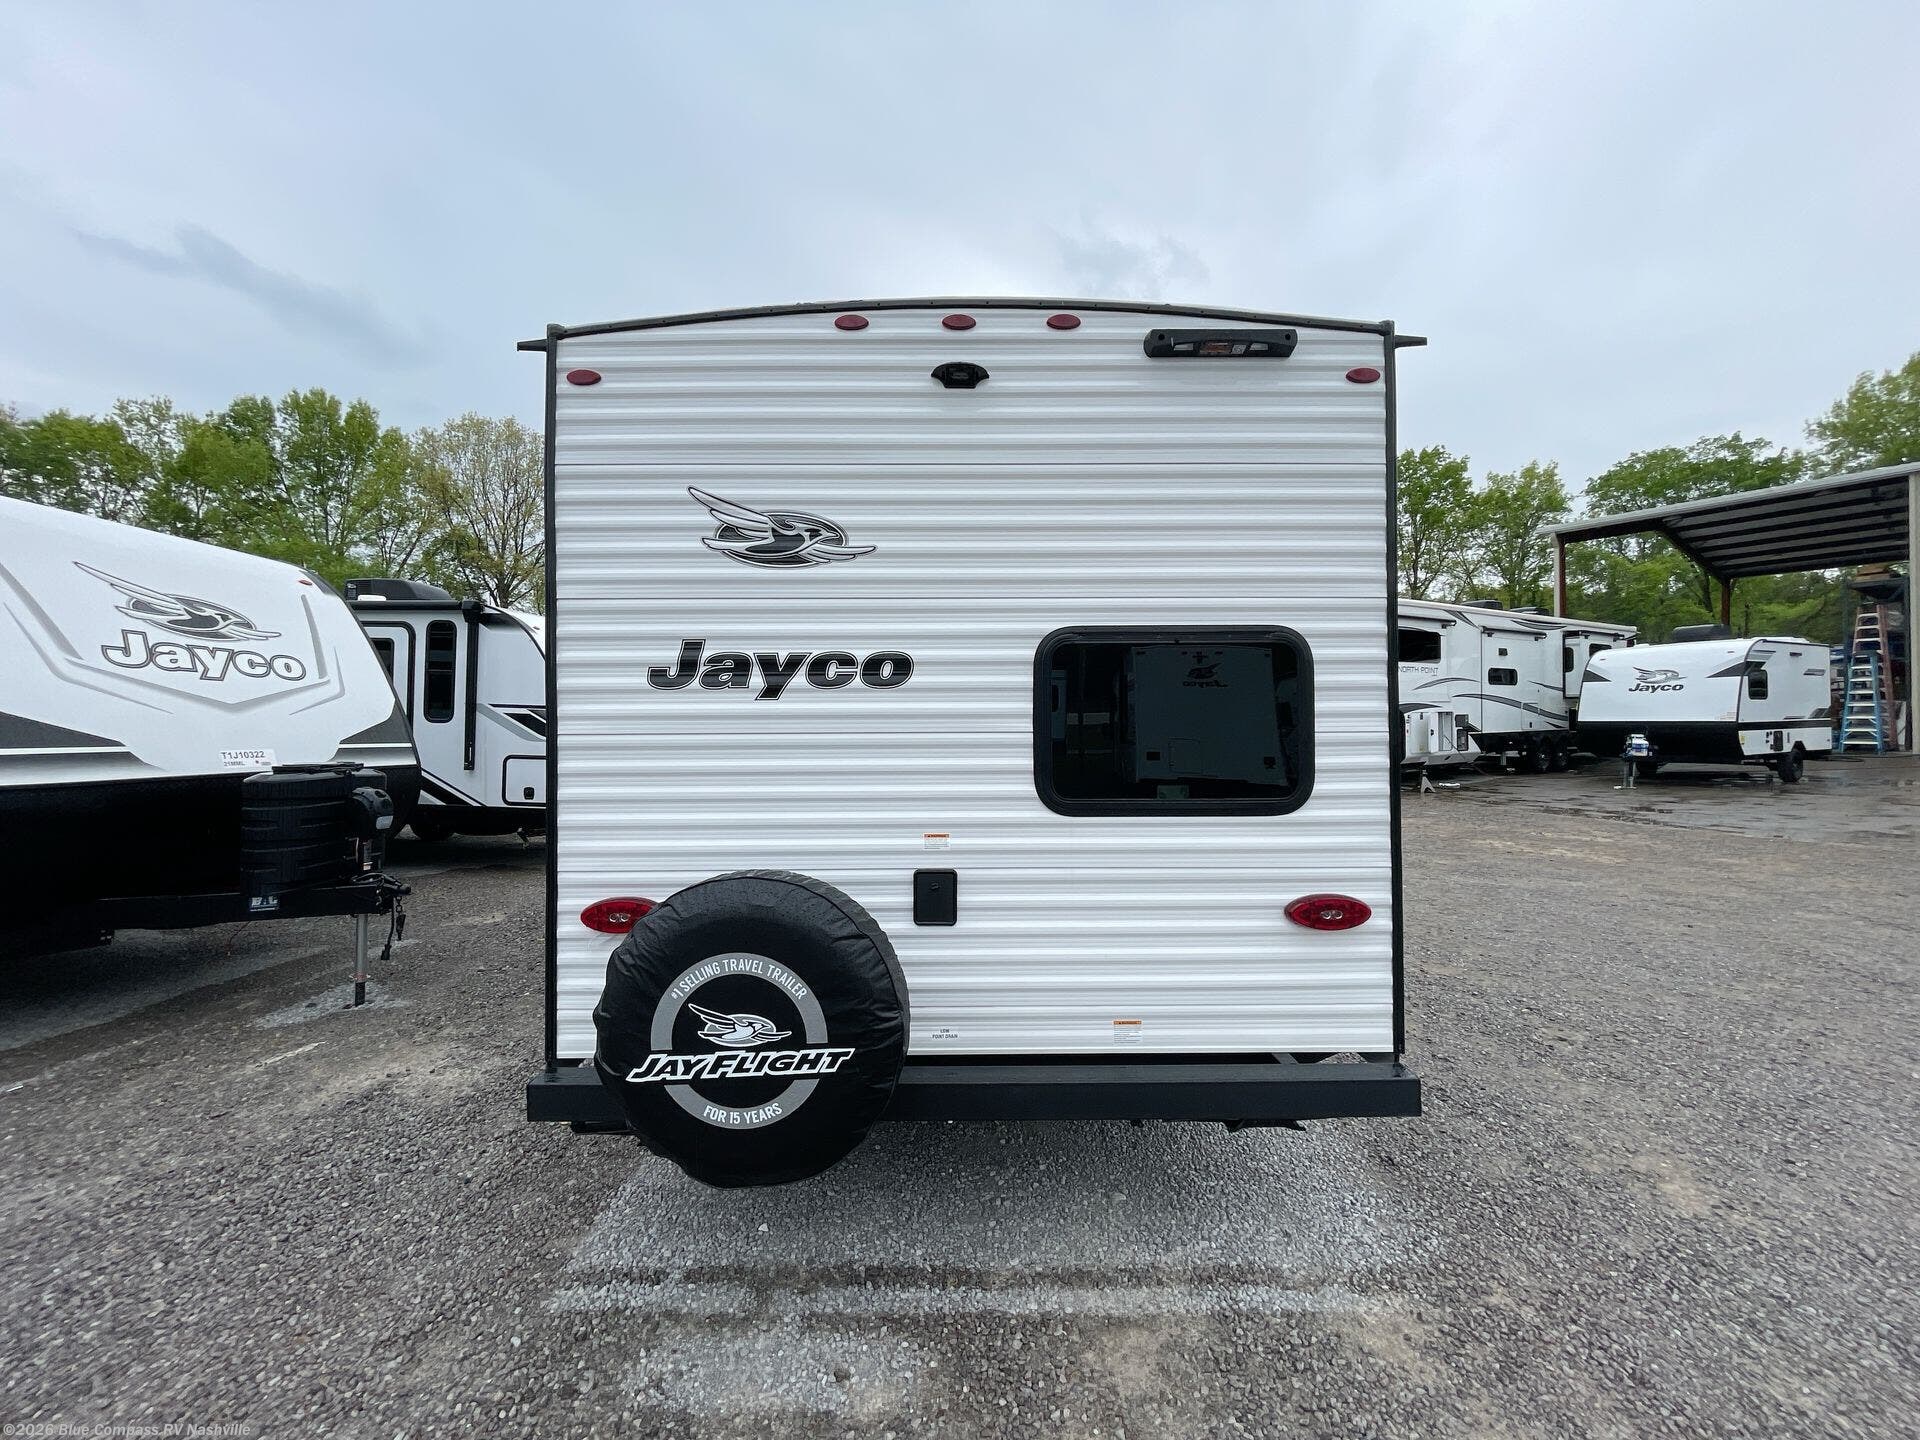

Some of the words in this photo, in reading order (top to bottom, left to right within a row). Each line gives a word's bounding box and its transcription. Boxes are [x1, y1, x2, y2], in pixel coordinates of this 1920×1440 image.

[101, 629, 307, 681] Jayco
[647, 638, 914, 701] Jayco
[1420, 666, 1438, 674] POINT
[1628, 683, 1684, 693] Jayco
[680, 963, 720, 992] SELLING
[722, 958, 763, 974] TRAVEL
[767, 964, 807, 1000] TRAILER
[703, 1105, 726, 1123] FOR
[729, 1111, 740, 1124] 15
[743, 1102, 783, 1124] YEARS
